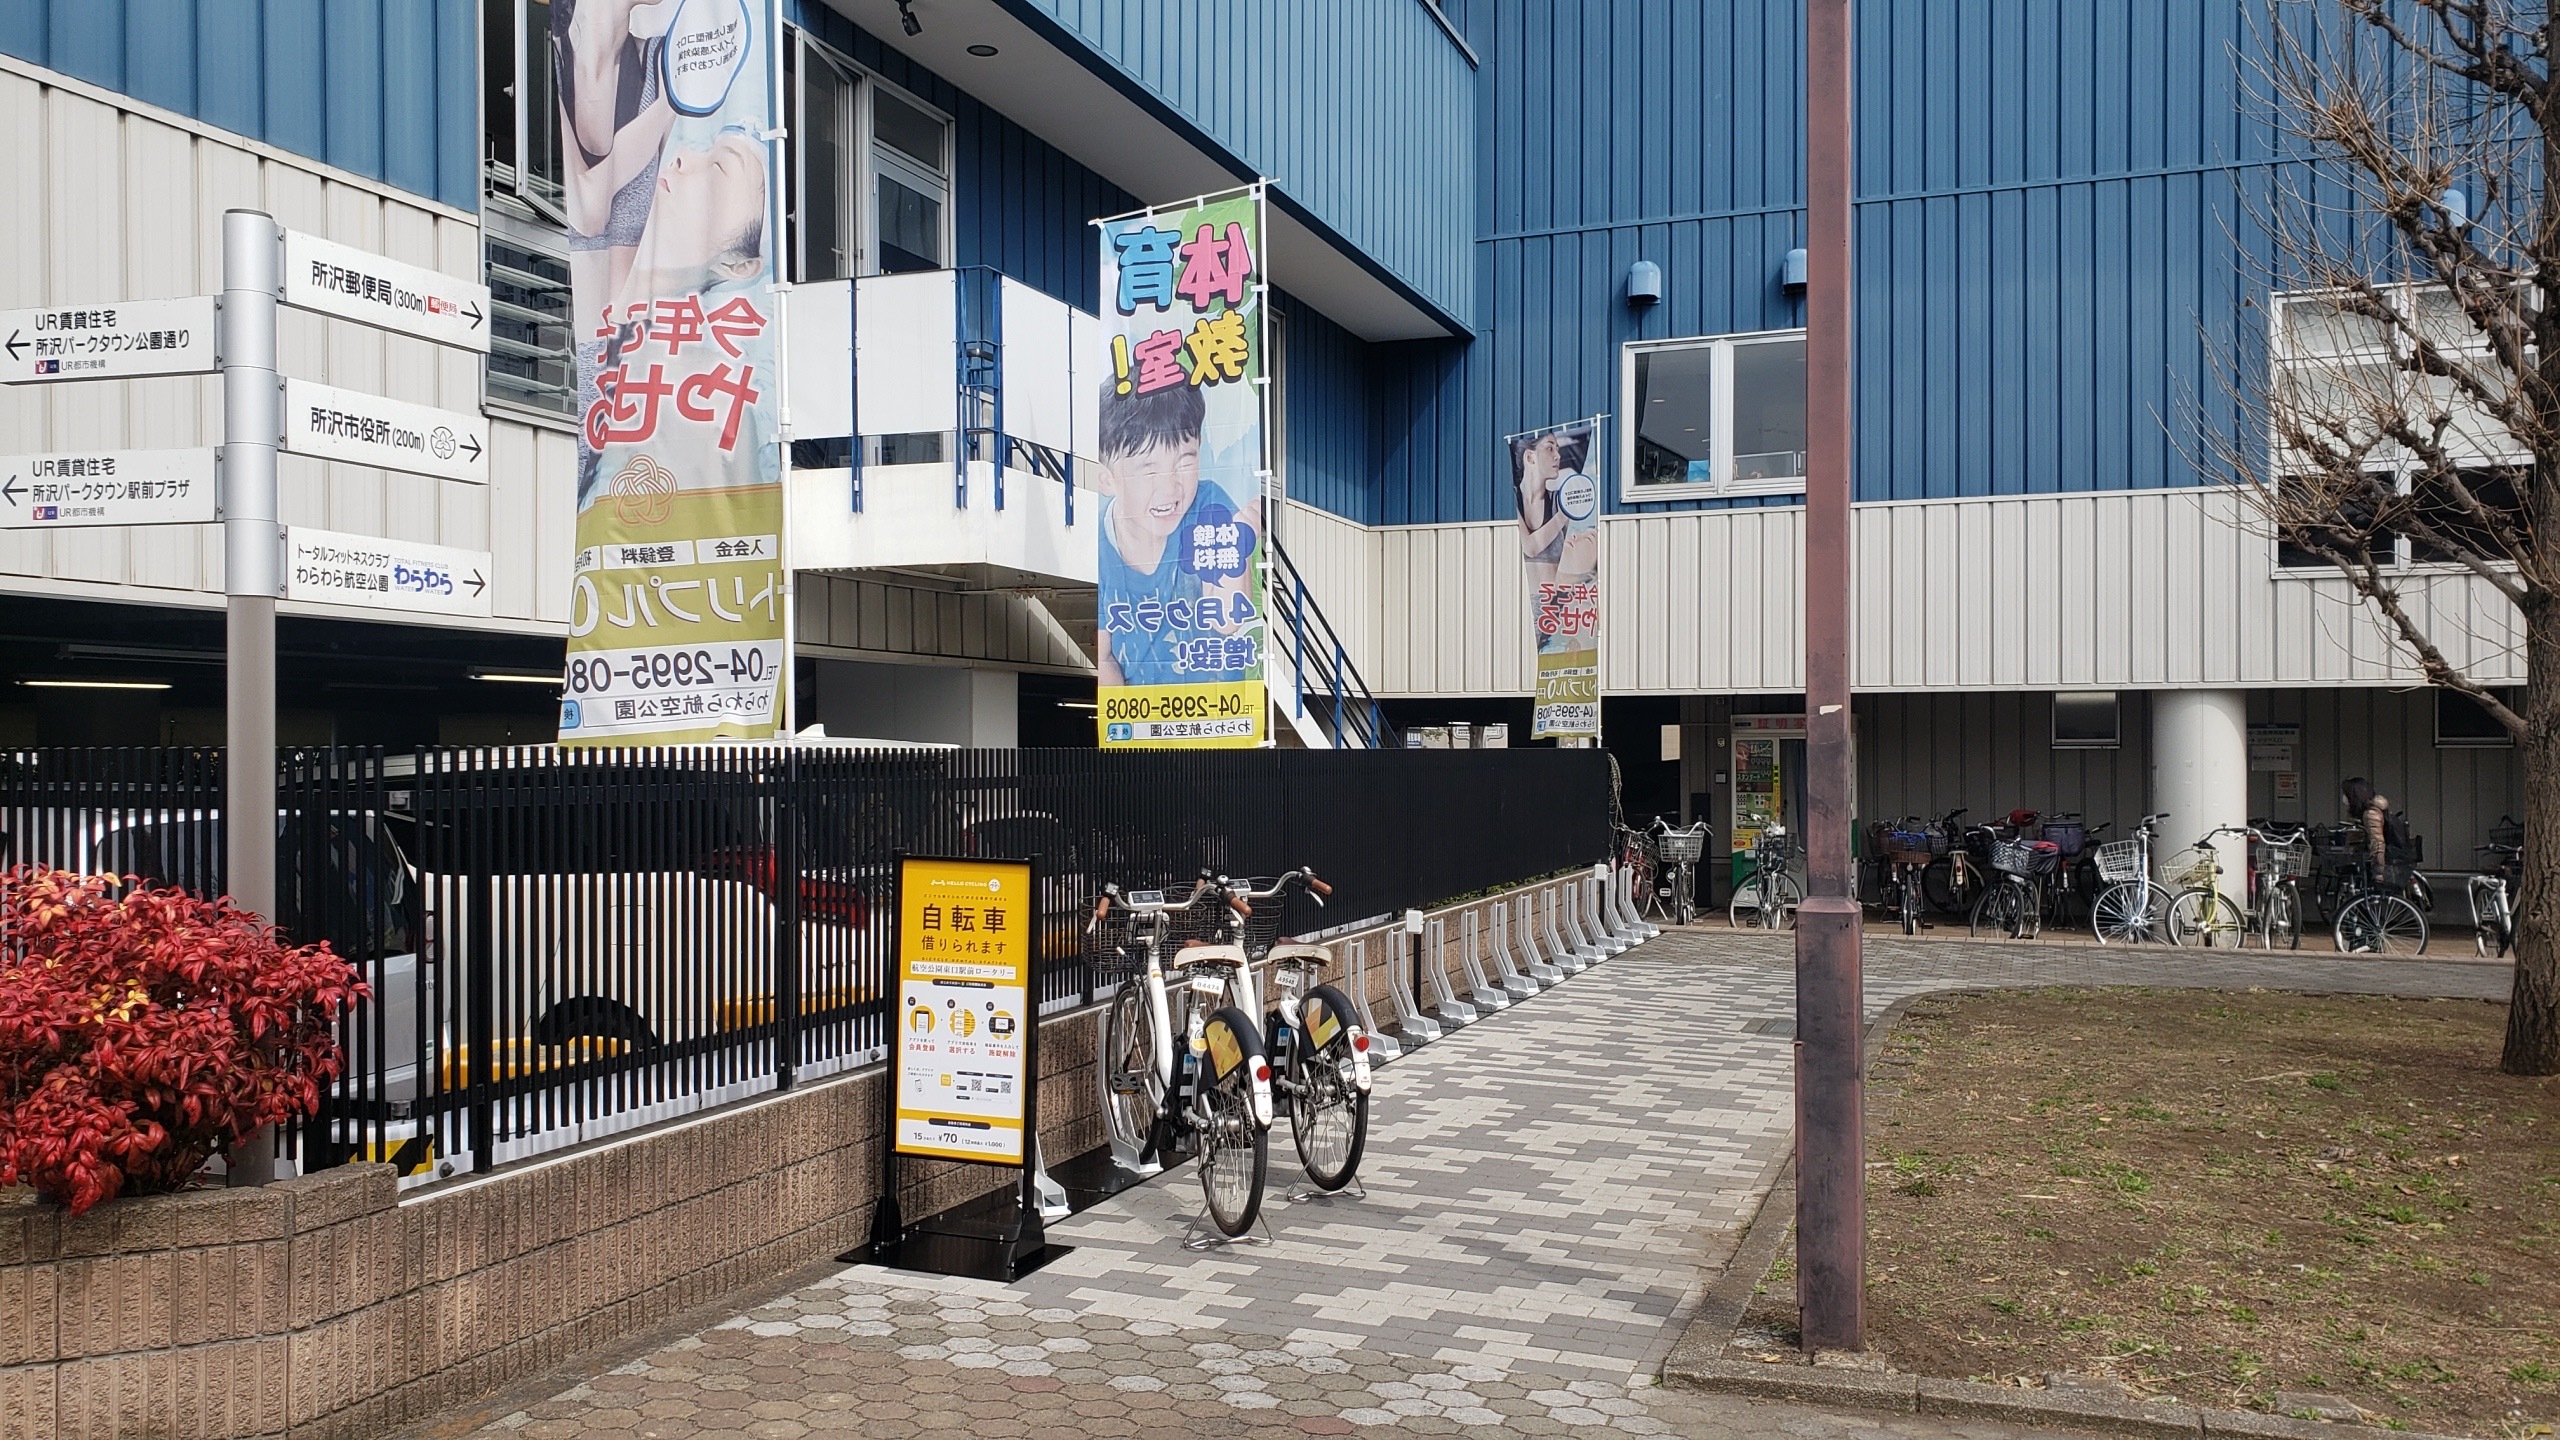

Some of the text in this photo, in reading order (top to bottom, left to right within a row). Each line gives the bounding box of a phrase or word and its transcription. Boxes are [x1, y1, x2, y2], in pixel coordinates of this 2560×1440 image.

[35, 309, 117, 331] UR賃貸住宅
[35, 329, 190, 356] 所沢パークタウン公園通り
[61, 359, 106, 371] UR都市機構
[32, 457, 116, 477] UR賃貸住宅
[32, 479, 190, 503] 所沢パークタウン駅前プラザ
[60, 506, 105, 518] UR都市機構
[298, 543, 390, 569] トータルフィットネスクラブ
[296, 565, 389, 592] わらわら航空公園
[394, 564, 454, 595] わらわら
[922, 903, 1006, 934] 自転車
[921, 934, 1007, 955] 借りられます
[911, 963, 1014, 977] 航空公園東口駅前ロータリー
